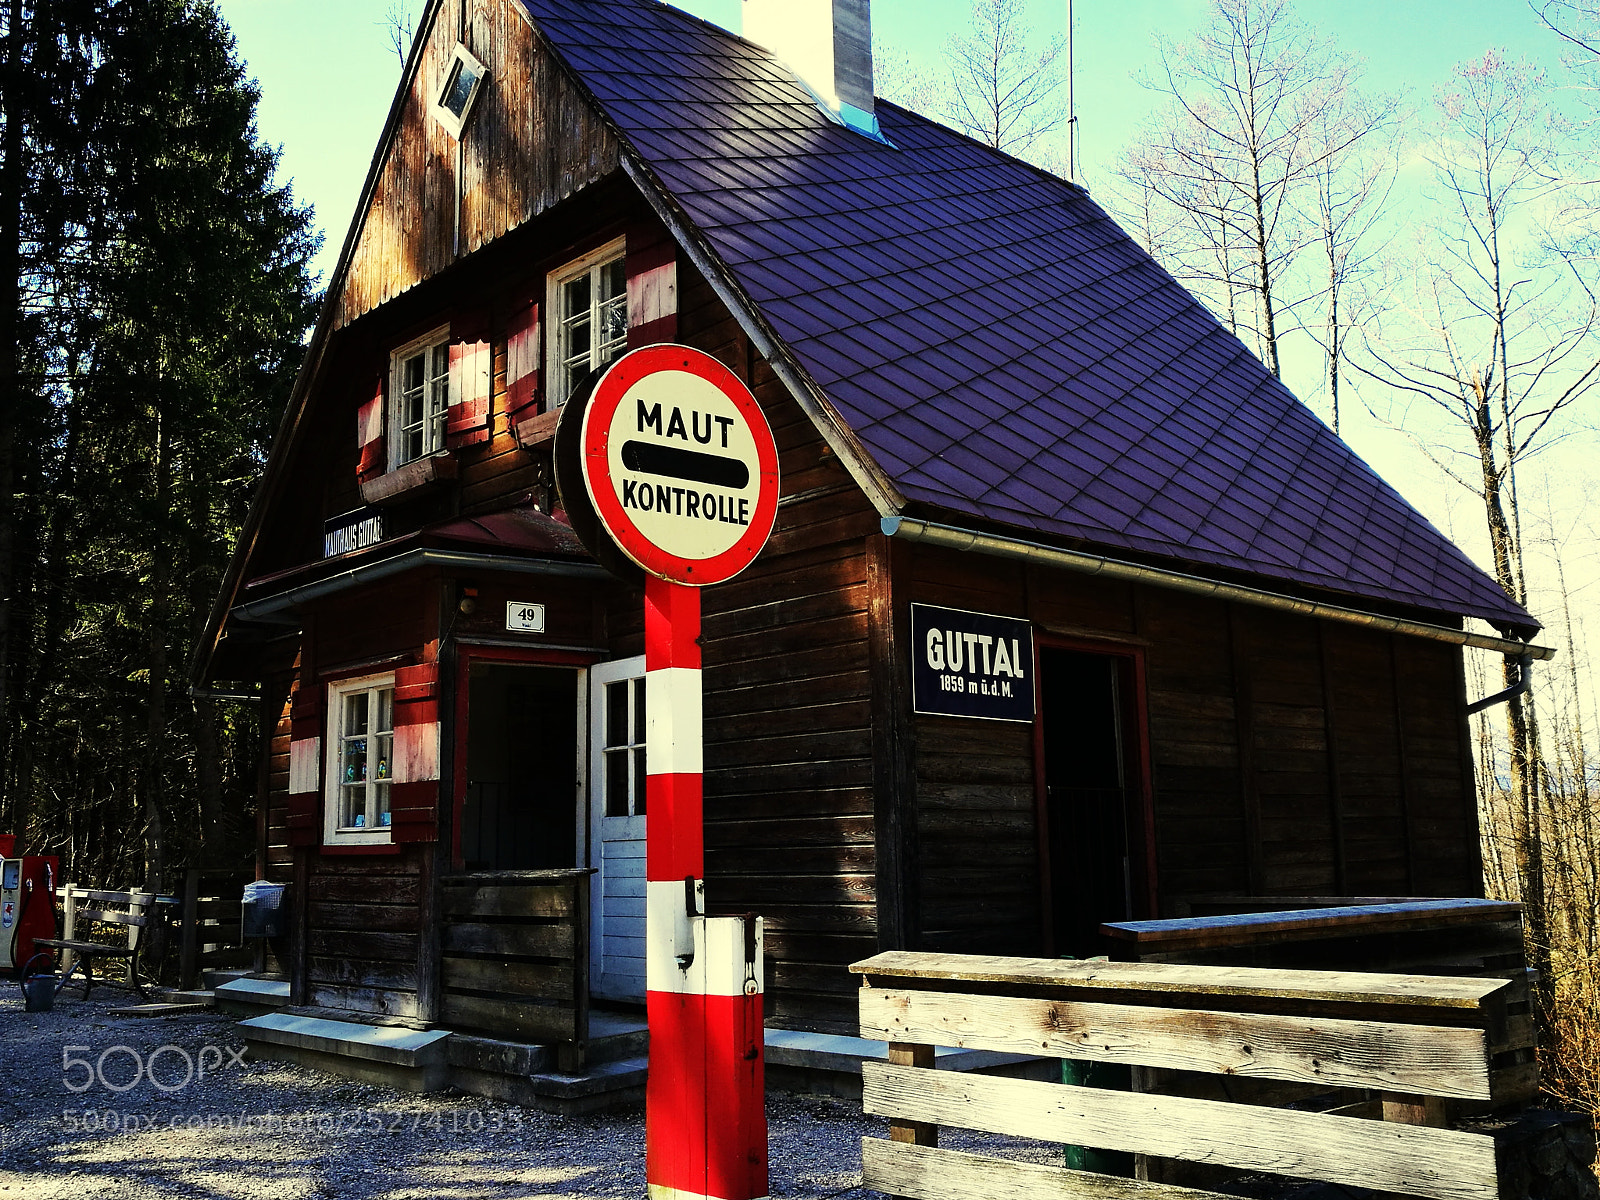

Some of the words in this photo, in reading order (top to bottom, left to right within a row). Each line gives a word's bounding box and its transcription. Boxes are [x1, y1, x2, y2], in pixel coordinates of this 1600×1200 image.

[636, 398, 735, 449] MAUT
[622, 478, 750, 527] KONTROLLE
[517, 607, 535, 622] 49
[926, 627, 1024, 679] GUTTAL
[939, 674, 965, 693] 1859
[968, 681, 979, 695] m
